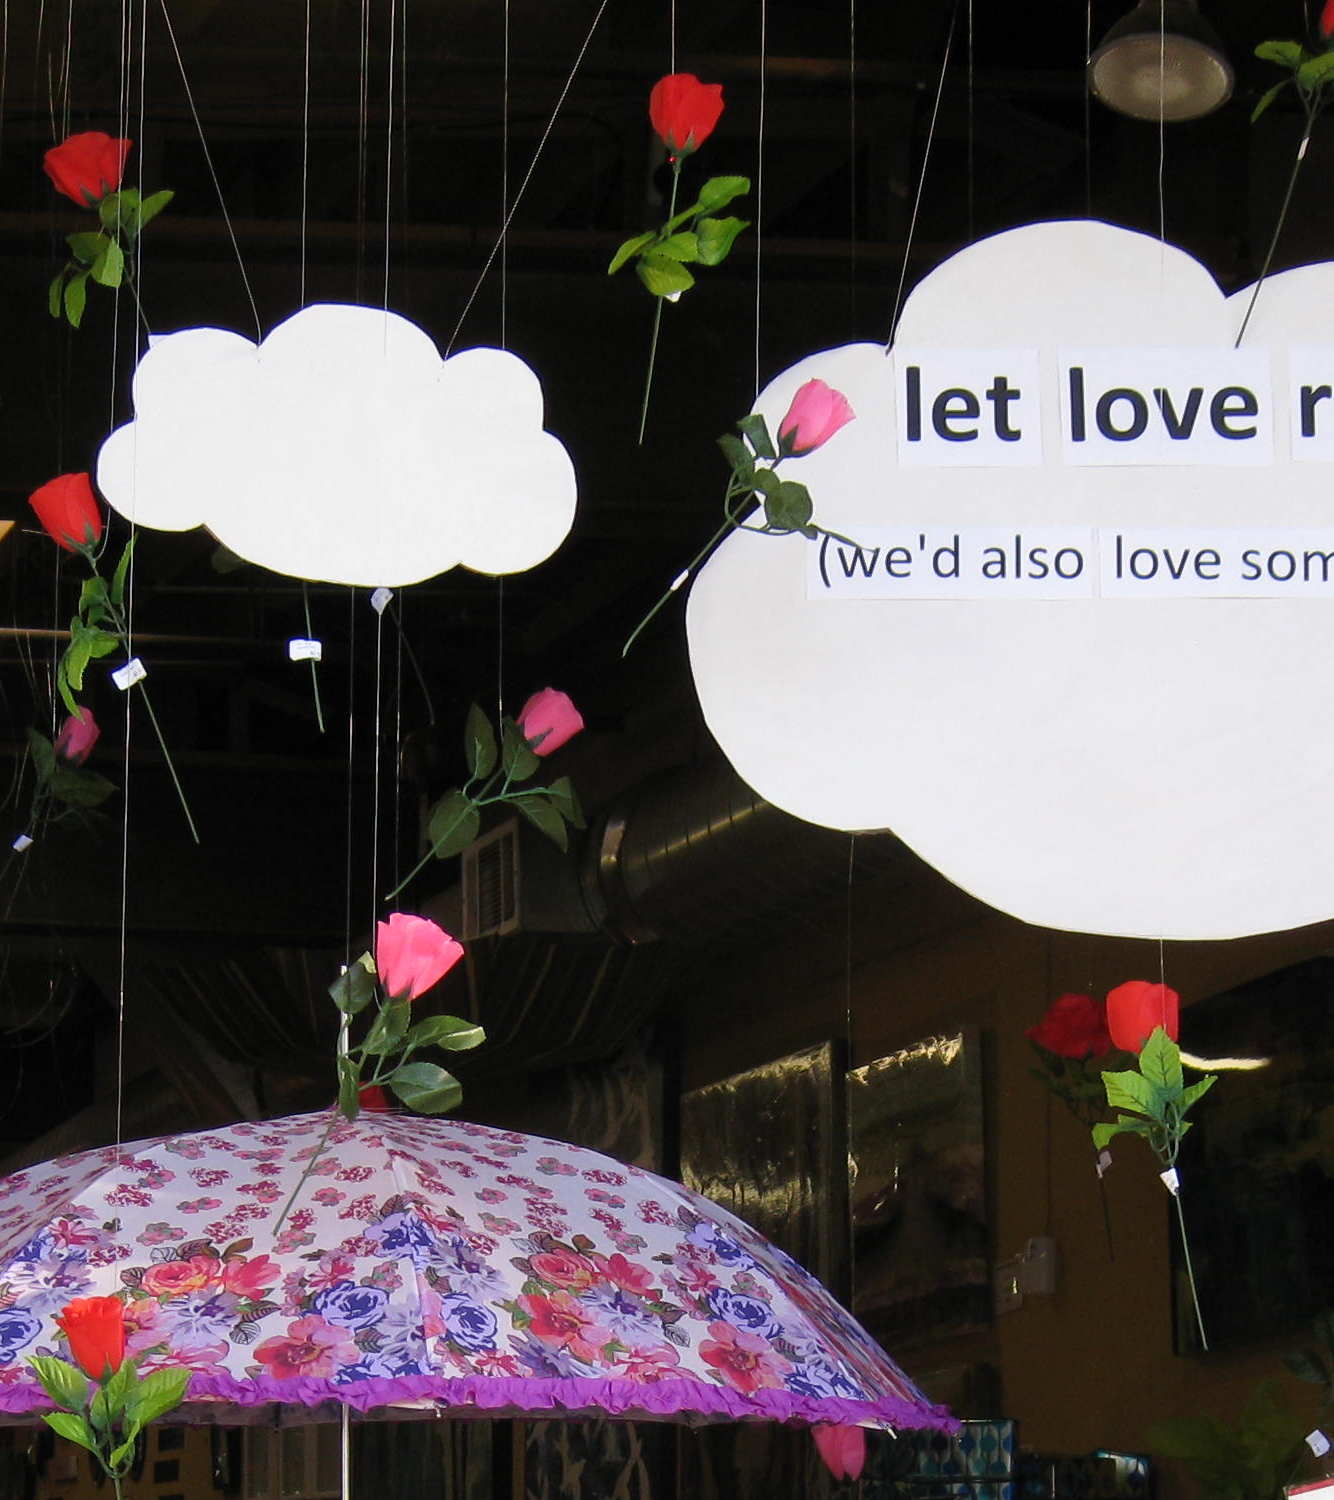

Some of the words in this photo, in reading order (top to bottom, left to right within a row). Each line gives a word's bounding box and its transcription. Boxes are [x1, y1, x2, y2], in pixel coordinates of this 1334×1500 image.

[904, 367, 1020, 442] let
[1067, 368, 1258, 442] love
[817, 538, 961, 589] (we'd
[981, 538, 1084, 582] also
[1114, 539, 1221, 583] love
